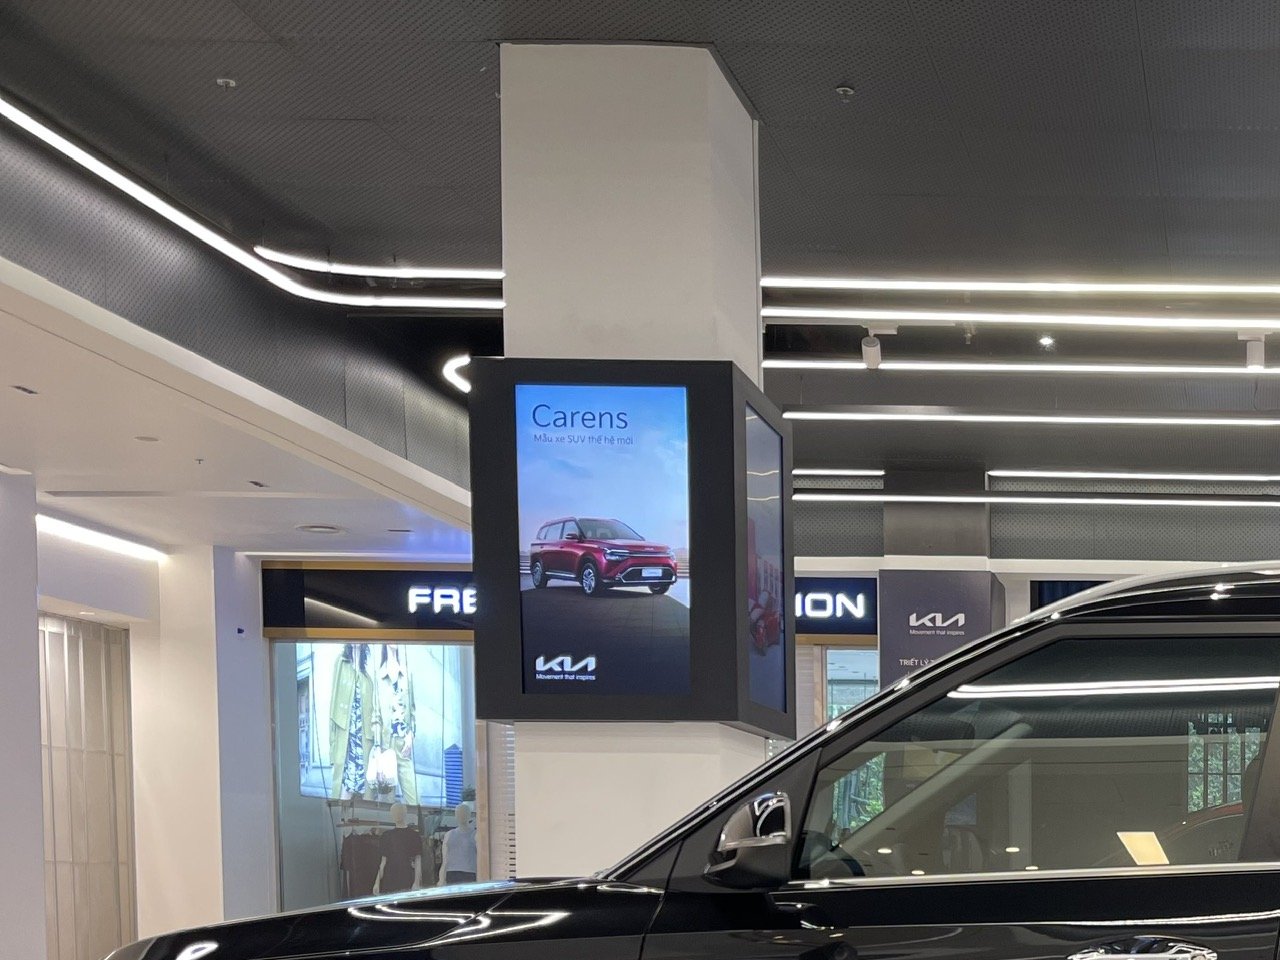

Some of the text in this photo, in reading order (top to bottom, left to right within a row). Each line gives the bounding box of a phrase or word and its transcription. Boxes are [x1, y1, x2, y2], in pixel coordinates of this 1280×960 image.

[532, 403, 628, 430] Carens
[567, 434, 586, 444] SUV
[909, 612, 965, 628] KIA
[535, 655, 596, 672] KIA
